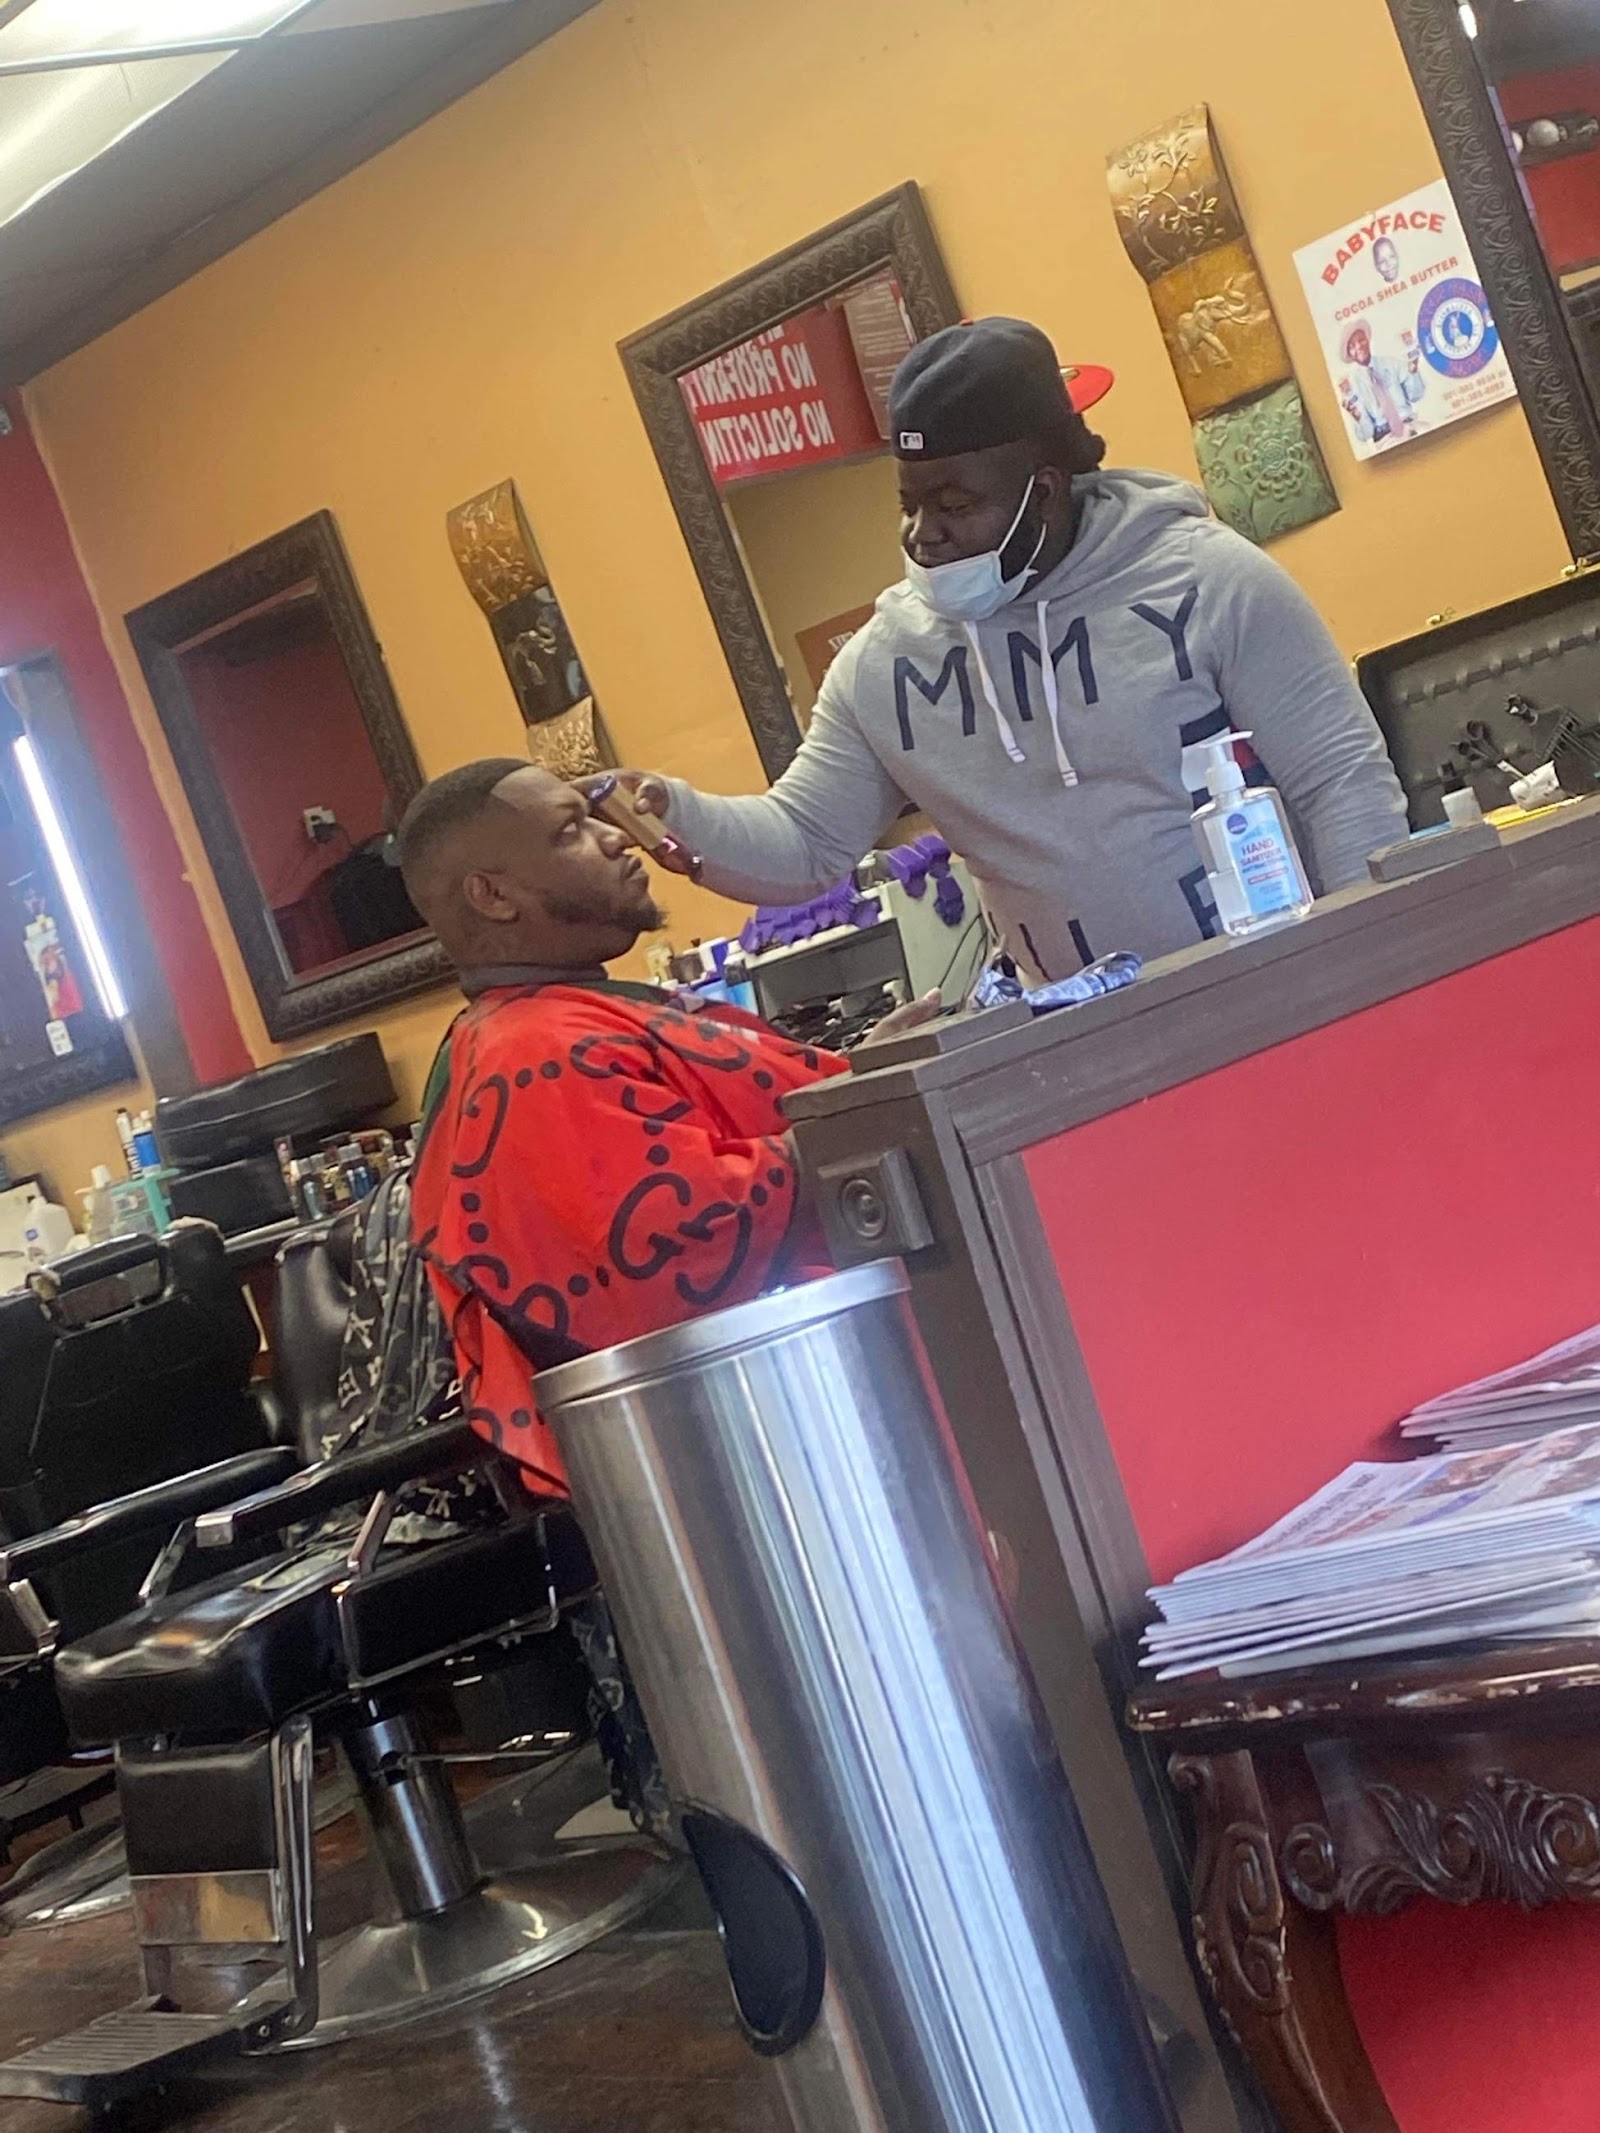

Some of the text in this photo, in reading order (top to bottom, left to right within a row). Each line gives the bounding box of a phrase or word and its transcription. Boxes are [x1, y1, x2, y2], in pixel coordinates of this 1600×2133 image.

[1321, 211, 1446, 286] BABYFACE
[1334, 256, 1459, 321] COCOA SHEA BUTTER
[1241, 837, 1275, 856] HAND
